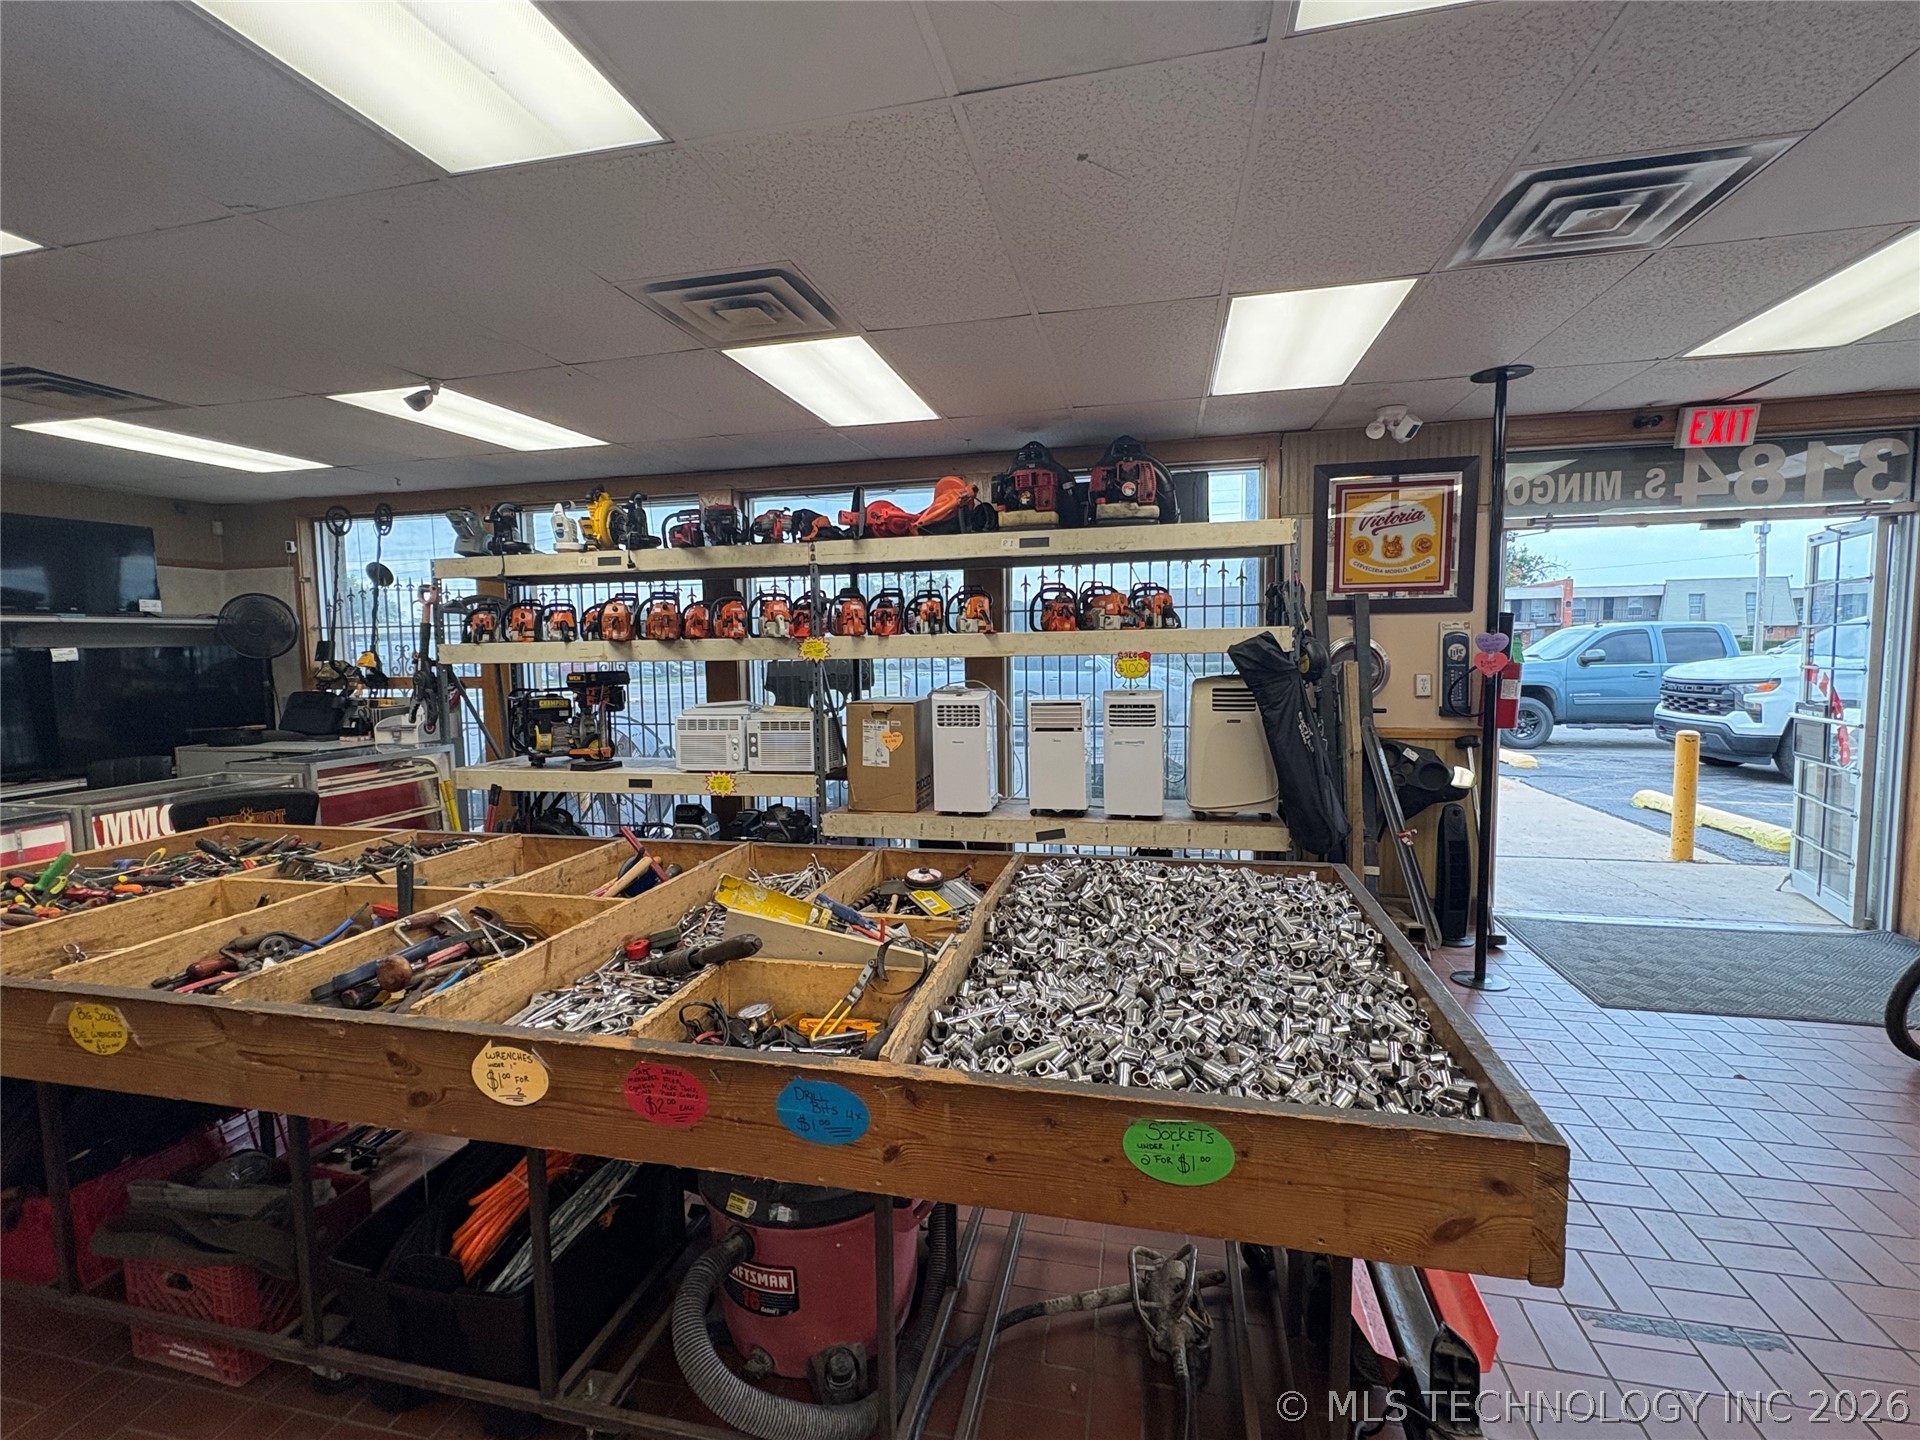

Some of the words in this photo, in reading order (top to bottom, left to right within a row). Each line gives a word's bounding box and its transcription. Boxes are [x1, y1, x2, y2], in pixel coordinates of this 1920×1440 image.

[1689, 408, 1755, 445] EXIT
[1357, 505, 1426, 534] Victoria
[1352, 560, 1384, 574] CERVECERIA
[1384, 566, 1409, 575] MODELO,
[1409, 558, 1432, 572] MEXICO
[485, 1050, 533, 1064] WRENCHES
[514, 1075, 530, 1085] FOR
[793, 1086, 829, 1103] DRILL
[680, 1104, 695, 1112] EACH
[1145, 1122, 1215, 1144] SOCKETS
[1136, 1143, 1165, 1151] UNDER
[1140, 1154, 1151, 1166] 2
[1153, 1154, 1174, 1165] FOR
[731, 1265, 789, 1289] AFTSMAN
[742, 1288, 760, 1310] 16
